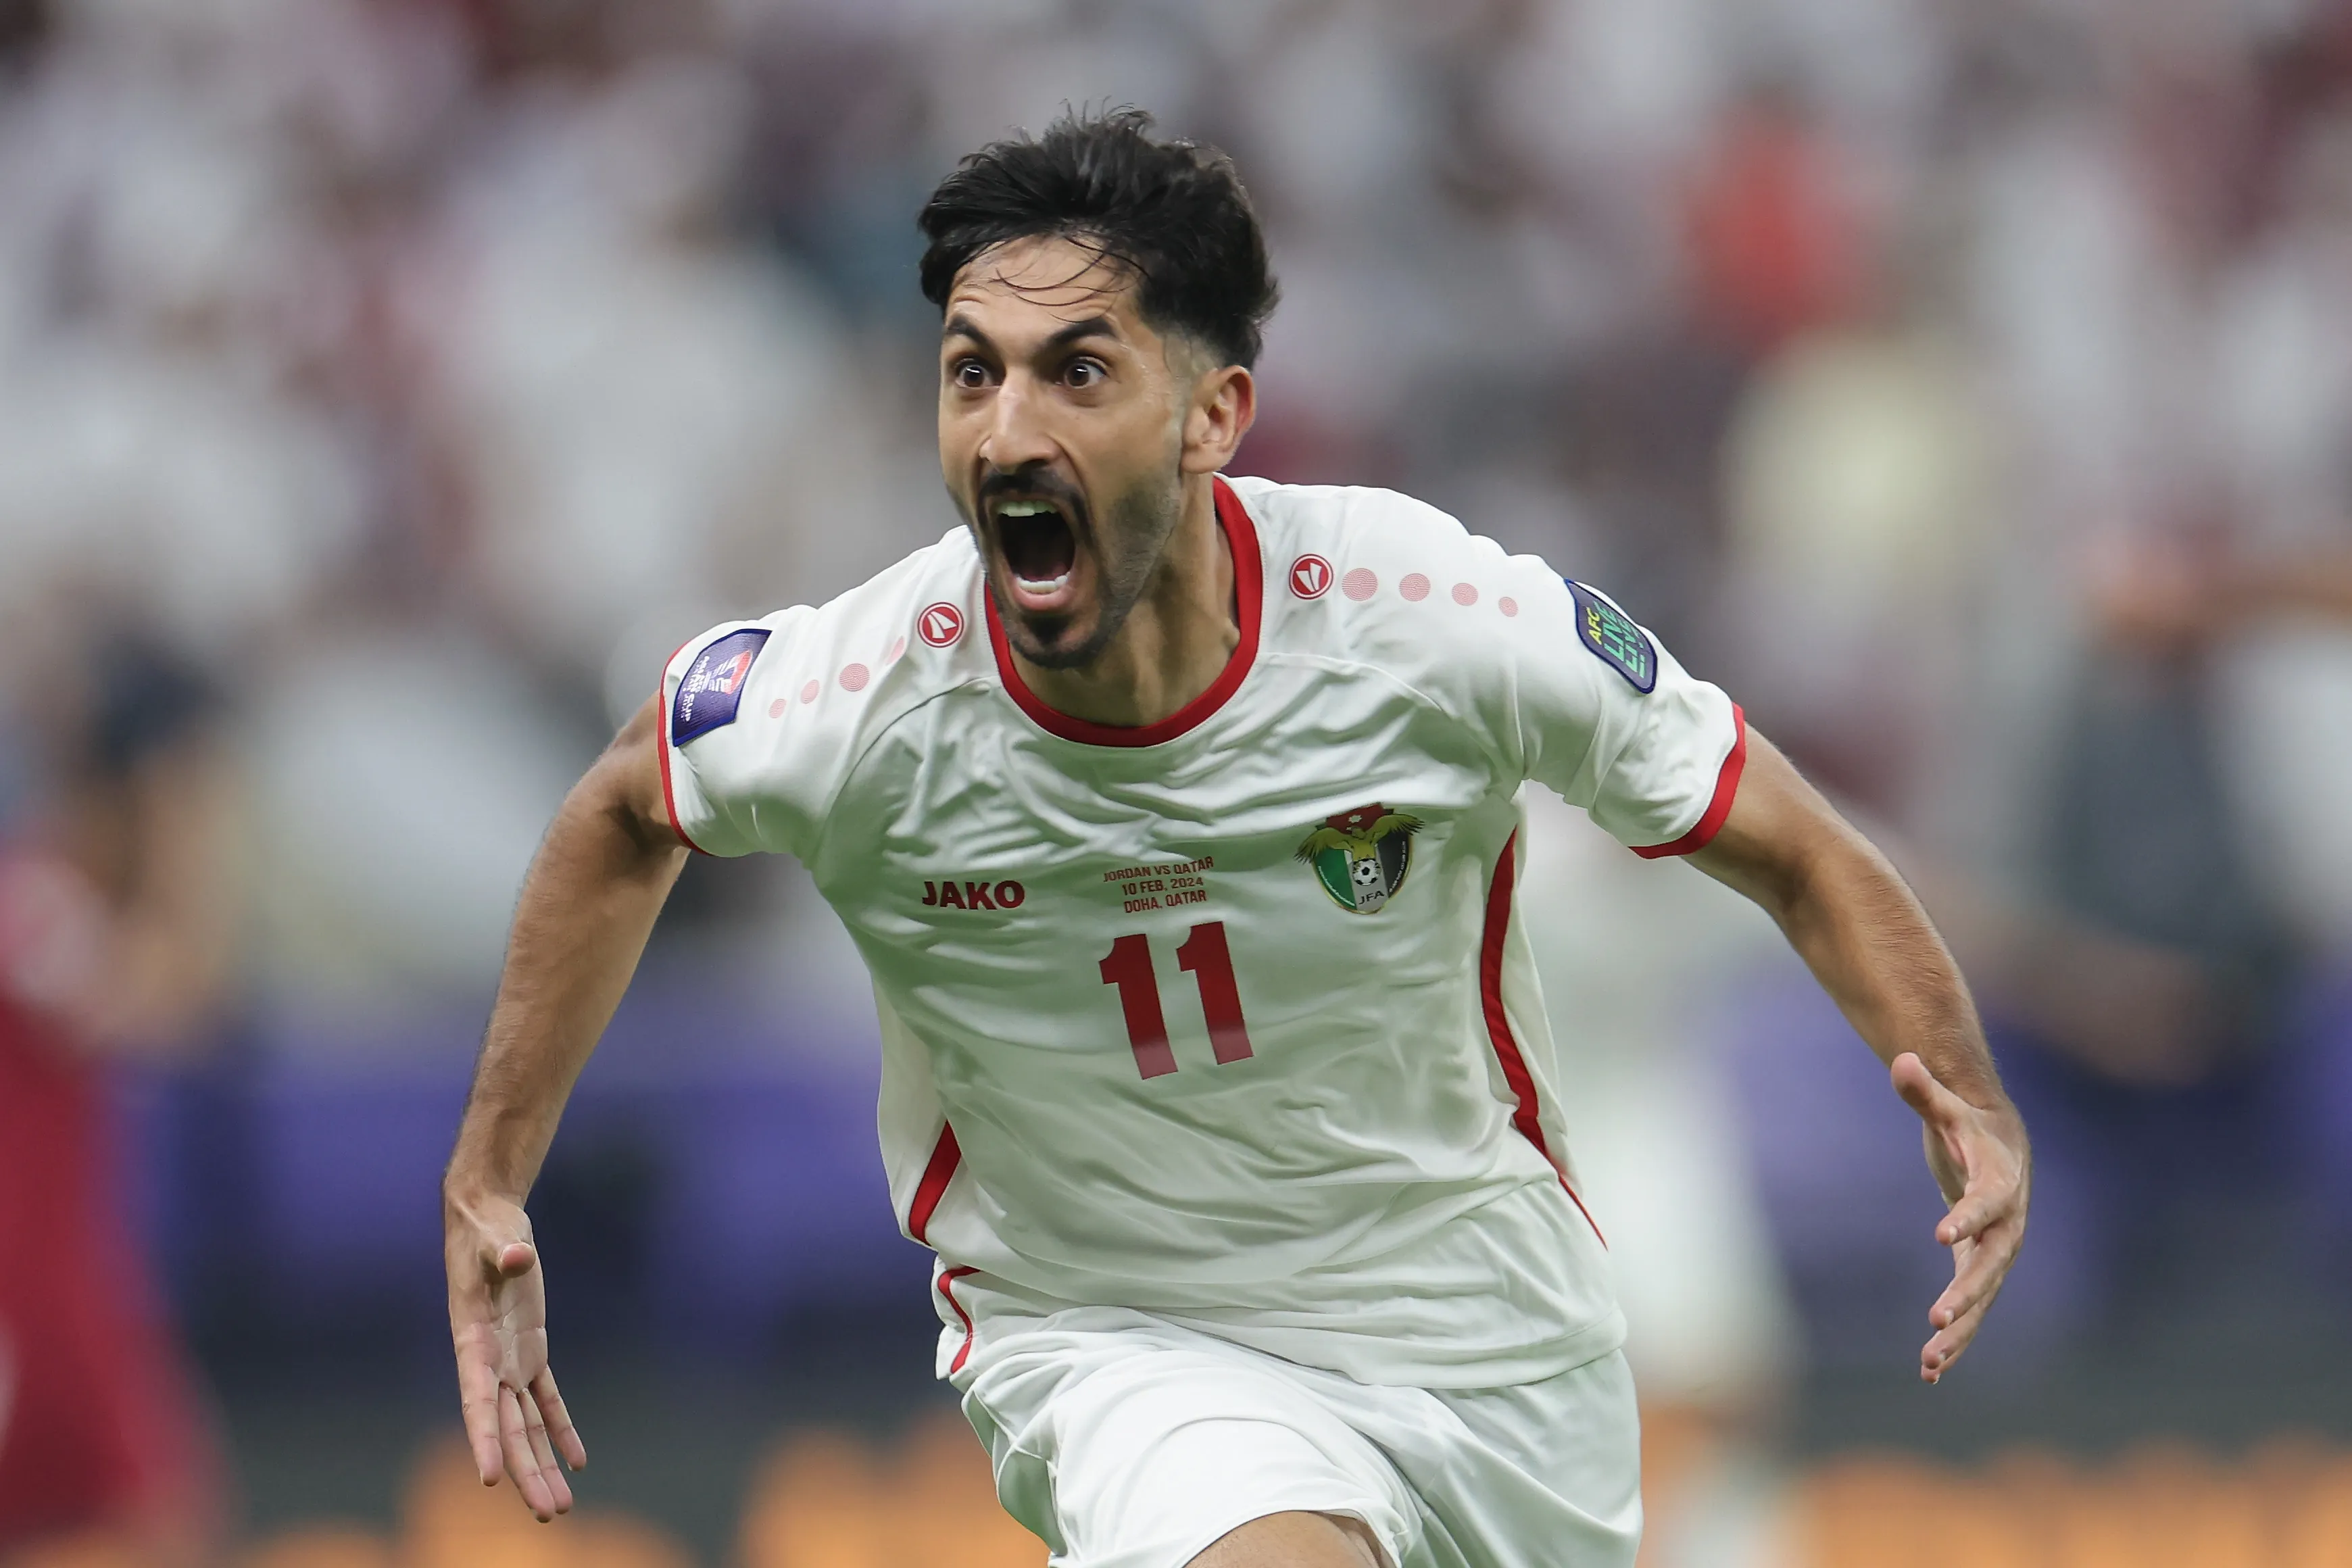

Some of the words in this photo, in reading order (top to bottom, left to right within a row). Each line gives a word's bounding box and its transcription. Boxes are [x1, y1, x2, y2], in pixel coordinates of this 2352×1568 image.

[1586, 607, 1602, 645] AFC
[1594, 601, 1624, 662] LIVE
[1104, 866, 1151, 882] JORDAN
[1154, 865, 1171, 875] VS
[1173, 856, 1214, 874] QATAR
[922, 880, 1025, 910] JAKO
[1122, 883, 1137, 896] 10
[1140, 880, 1168, 893] FEB.
[1170, 877, 1204, 889] 2024
[1166, 889, 1206, 906] QATAR
[1358, 890, 1385, 905] JFA
[1099, 921, 1253, 1079] 11
